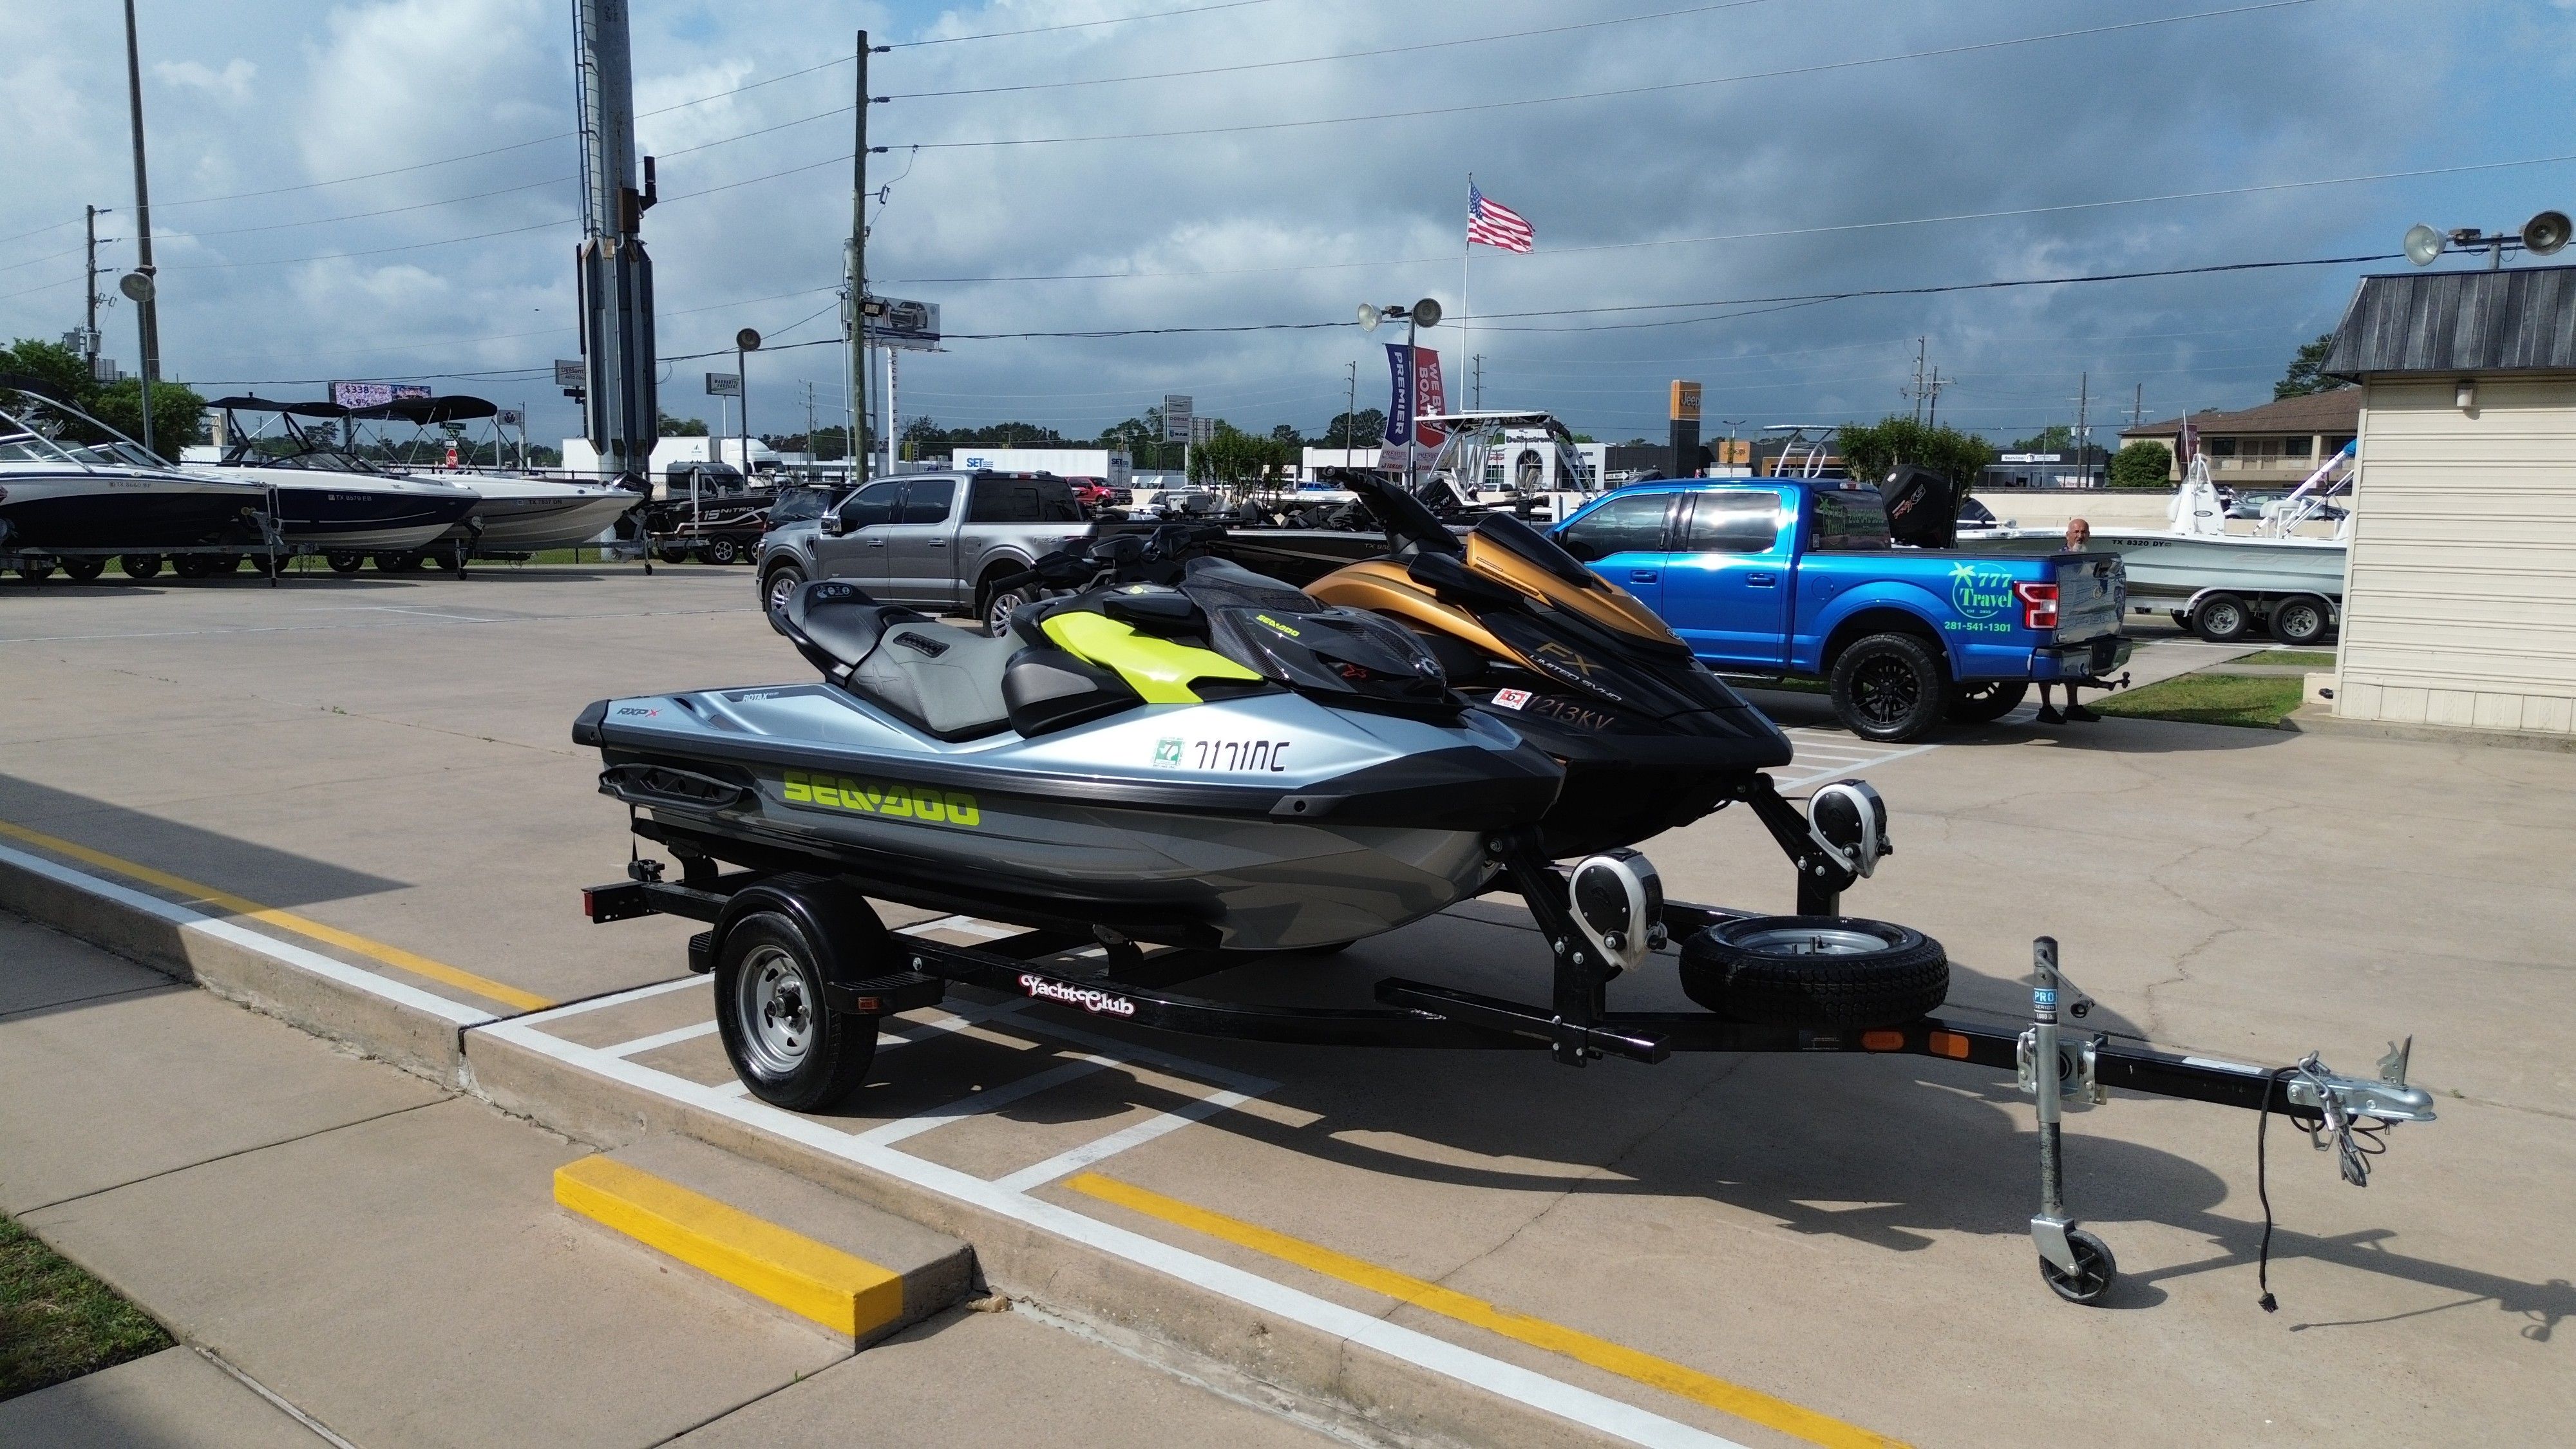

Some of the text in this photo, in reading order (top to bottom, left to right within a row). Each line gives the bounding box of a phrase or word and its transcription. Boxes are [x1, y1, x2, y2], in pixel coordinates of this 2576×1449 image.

[1429, 363, 1440, 391] WE
[345, 385, 370, 394] $338
[1394, 352, 1405, 435] PREMIER
[1681, 392, 1700, 409] Jeep
[967, 458, 984, 468] SET
[720, 506, 755, 515] NITRO
[1034, 536, 1059, 544] FX4
[1978, 573, 2013, 588] 777
[1960, 588, 2013, 608] Travel
[1944, 621, 2011, 632] 281-541-1301
[1535, 642, 1605, 677] FX
[1528, 654, 1580, 681] LIMITED
[742, 693, 768, 703] ROTAX
[1506, 692, 1518, 701] 6
[2035, 990, 2054, 1002] PRO
